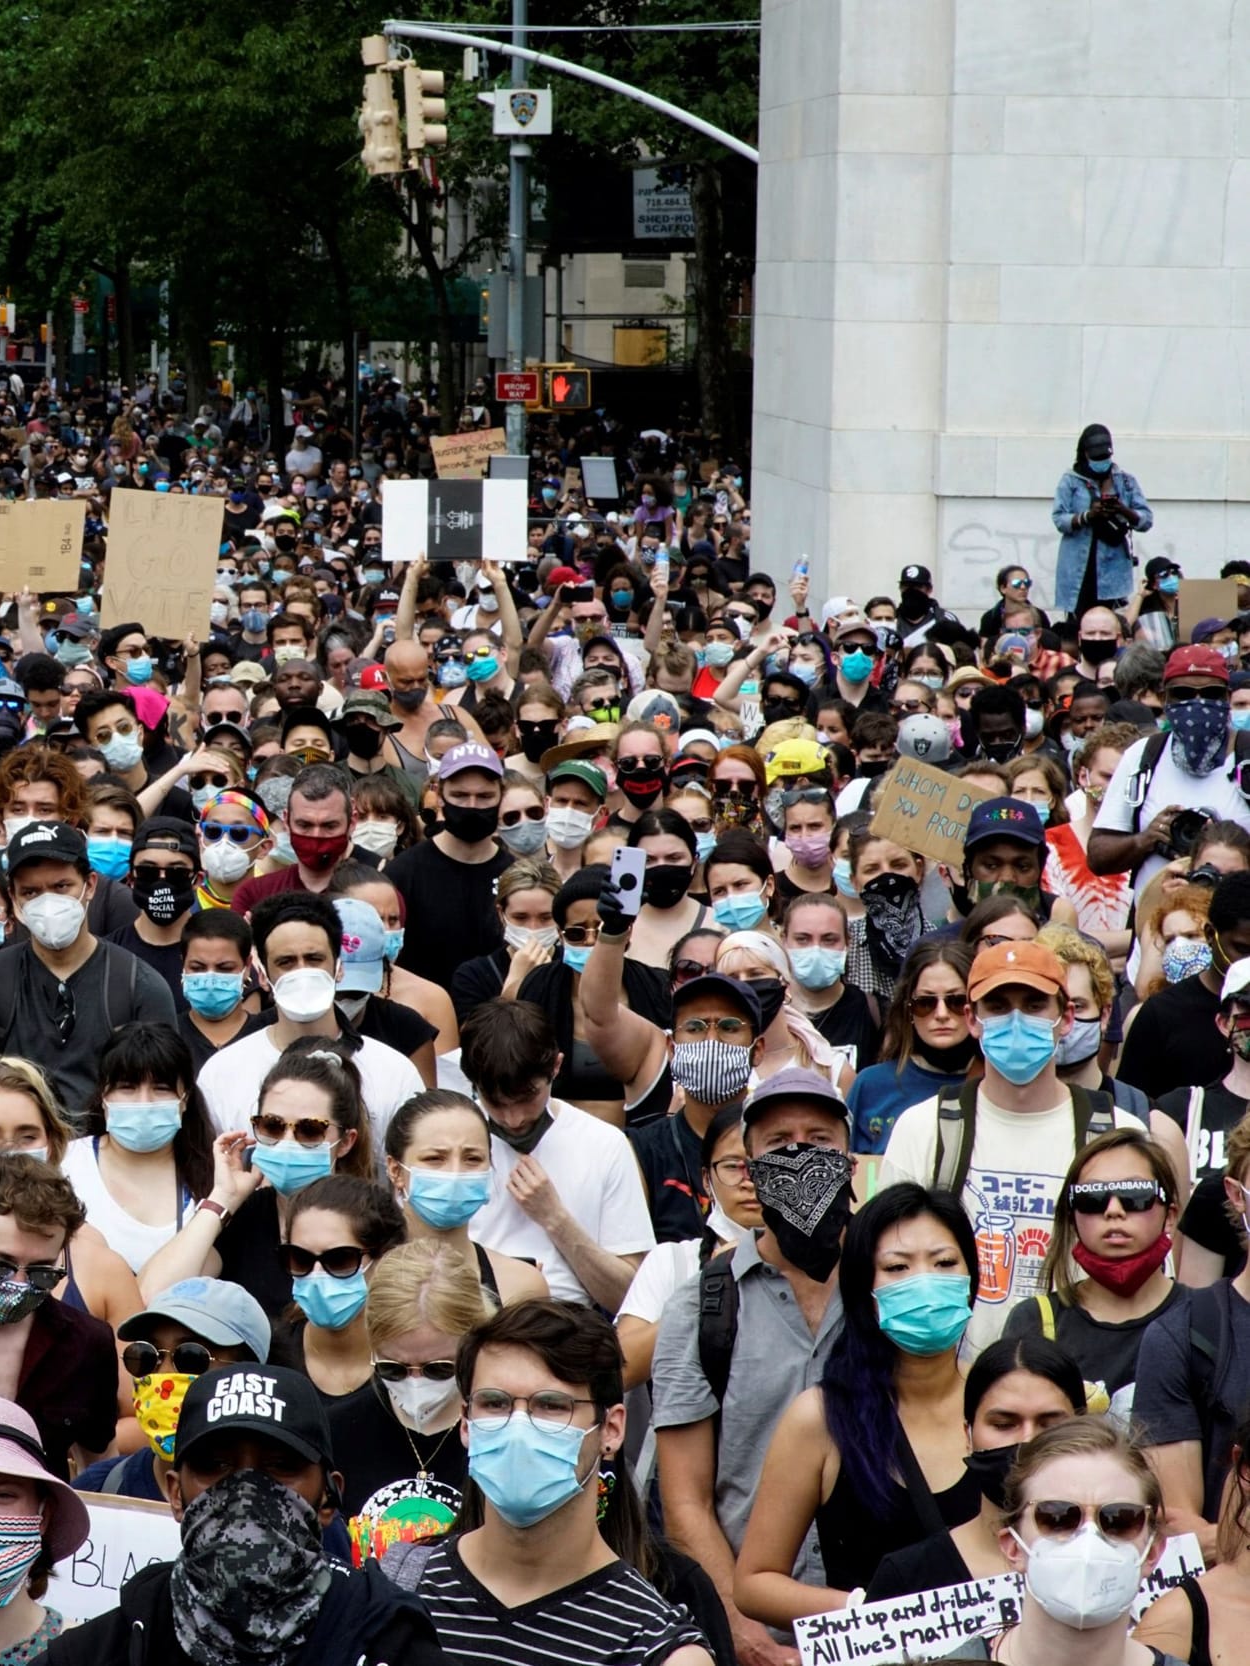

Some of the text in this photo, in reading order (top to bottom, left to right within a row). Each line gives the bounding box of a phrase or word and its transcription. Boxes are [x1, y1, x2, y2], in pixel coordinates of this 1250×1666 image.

[644, 224, 696, 234] SCAFFOL
[503, 383, 531, 391] WRONG
[125, 533, 201, 582] GO
[107, 583, 205, 633] VOTE
[452, 743, 490, 760] NYU
[895, 767, 948, 804] WHOM
[893, 797, 967, 843] YOU PROT
[148, 895, 175, 904] SOCIAL
[153, 888, 171, 896] ANTI
[148, 904, 175, 912] SOCIAL
[981, 1175, 1045, 1193] コーヒー
[1074, 1182, 1104, 1193] DOLCE
[1108, 1181, 1154, 1190] GABBANA
[214, 1373, 278, 1397] EAST
[207, 1392, 287, 1422] COAST
[865, 1611, 889, 1631] up
[893, 1594, 926, 1622] and
[845, 1632, 897, 1661] lives
